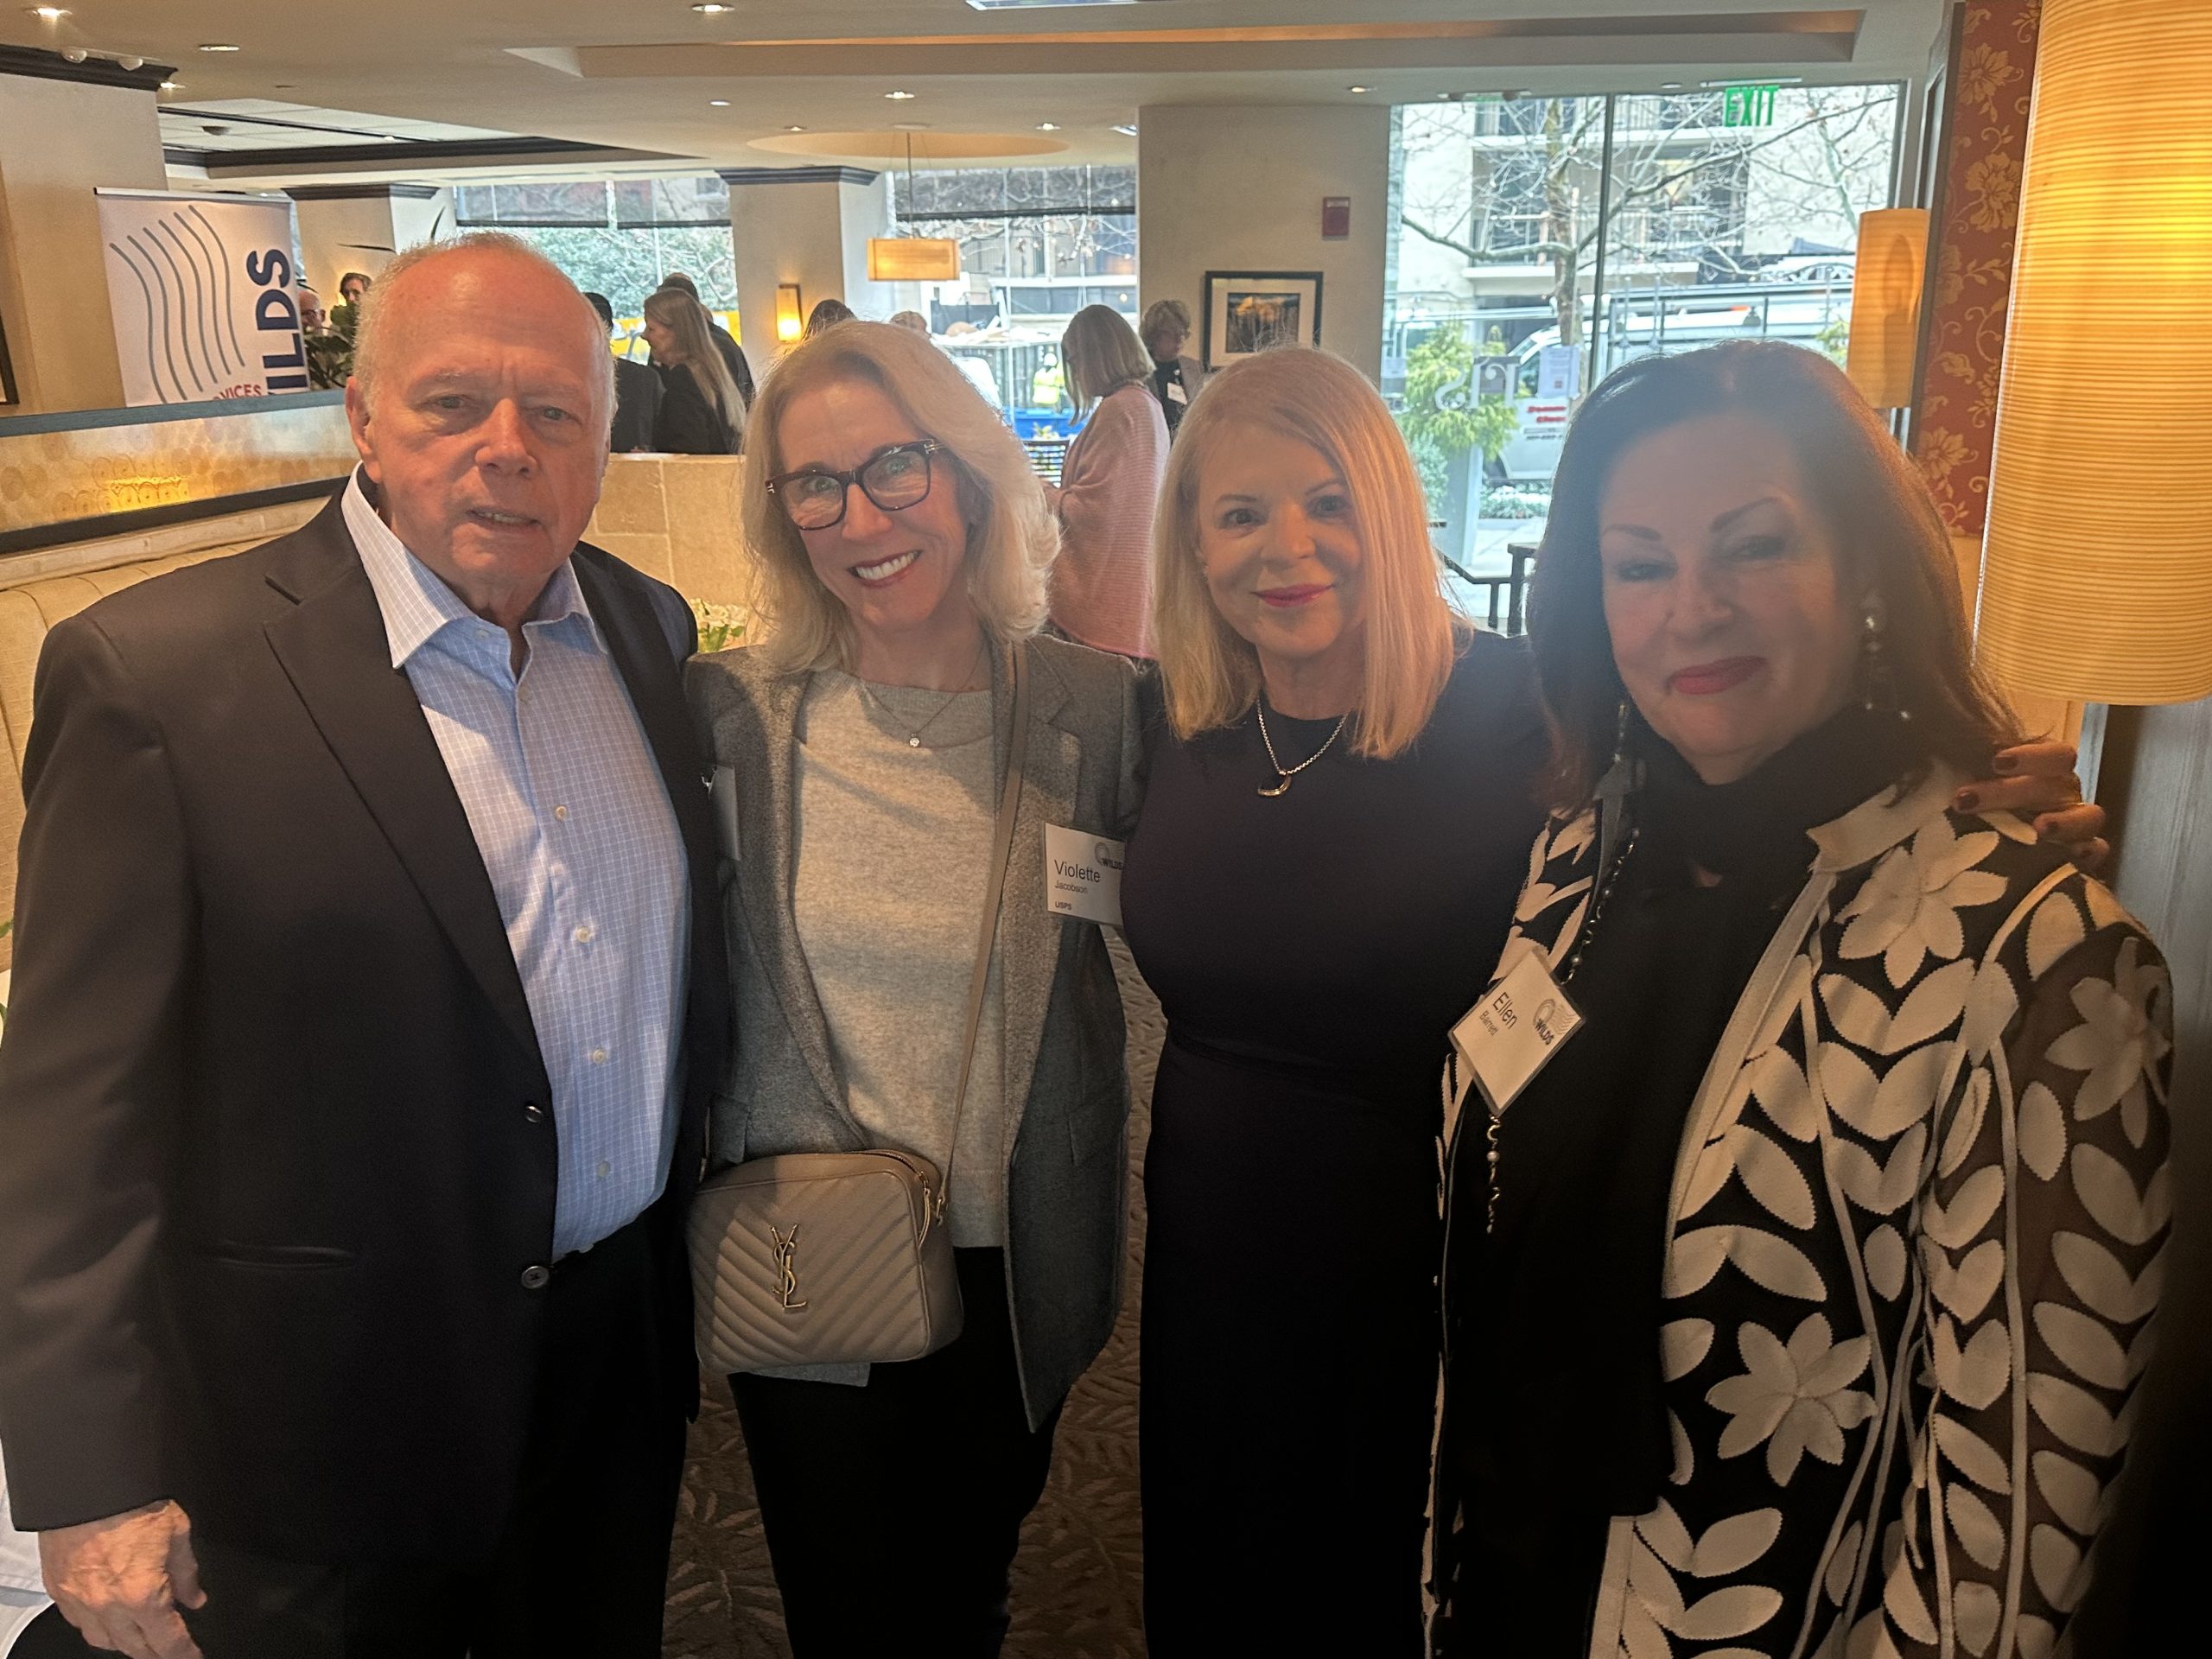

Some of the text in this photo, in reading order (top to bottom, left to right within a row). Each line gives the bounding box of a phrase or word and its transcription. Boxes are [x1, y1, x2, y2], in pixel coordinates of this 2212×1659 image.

[1724, 85, 1780, 127] EXIT
[246, 248, 308, 396] ILDS
[1053, 859, 1102, 883] Violette
[1054, 880, 1089, 894] Jacobson
[1054, 900, 1072, 911] USPS
[1492, 991, 1519, 1029] Ellen
[1535, 1019, 1554, 1046] WILDS
[771, 1223, 808, 1308] YSL
